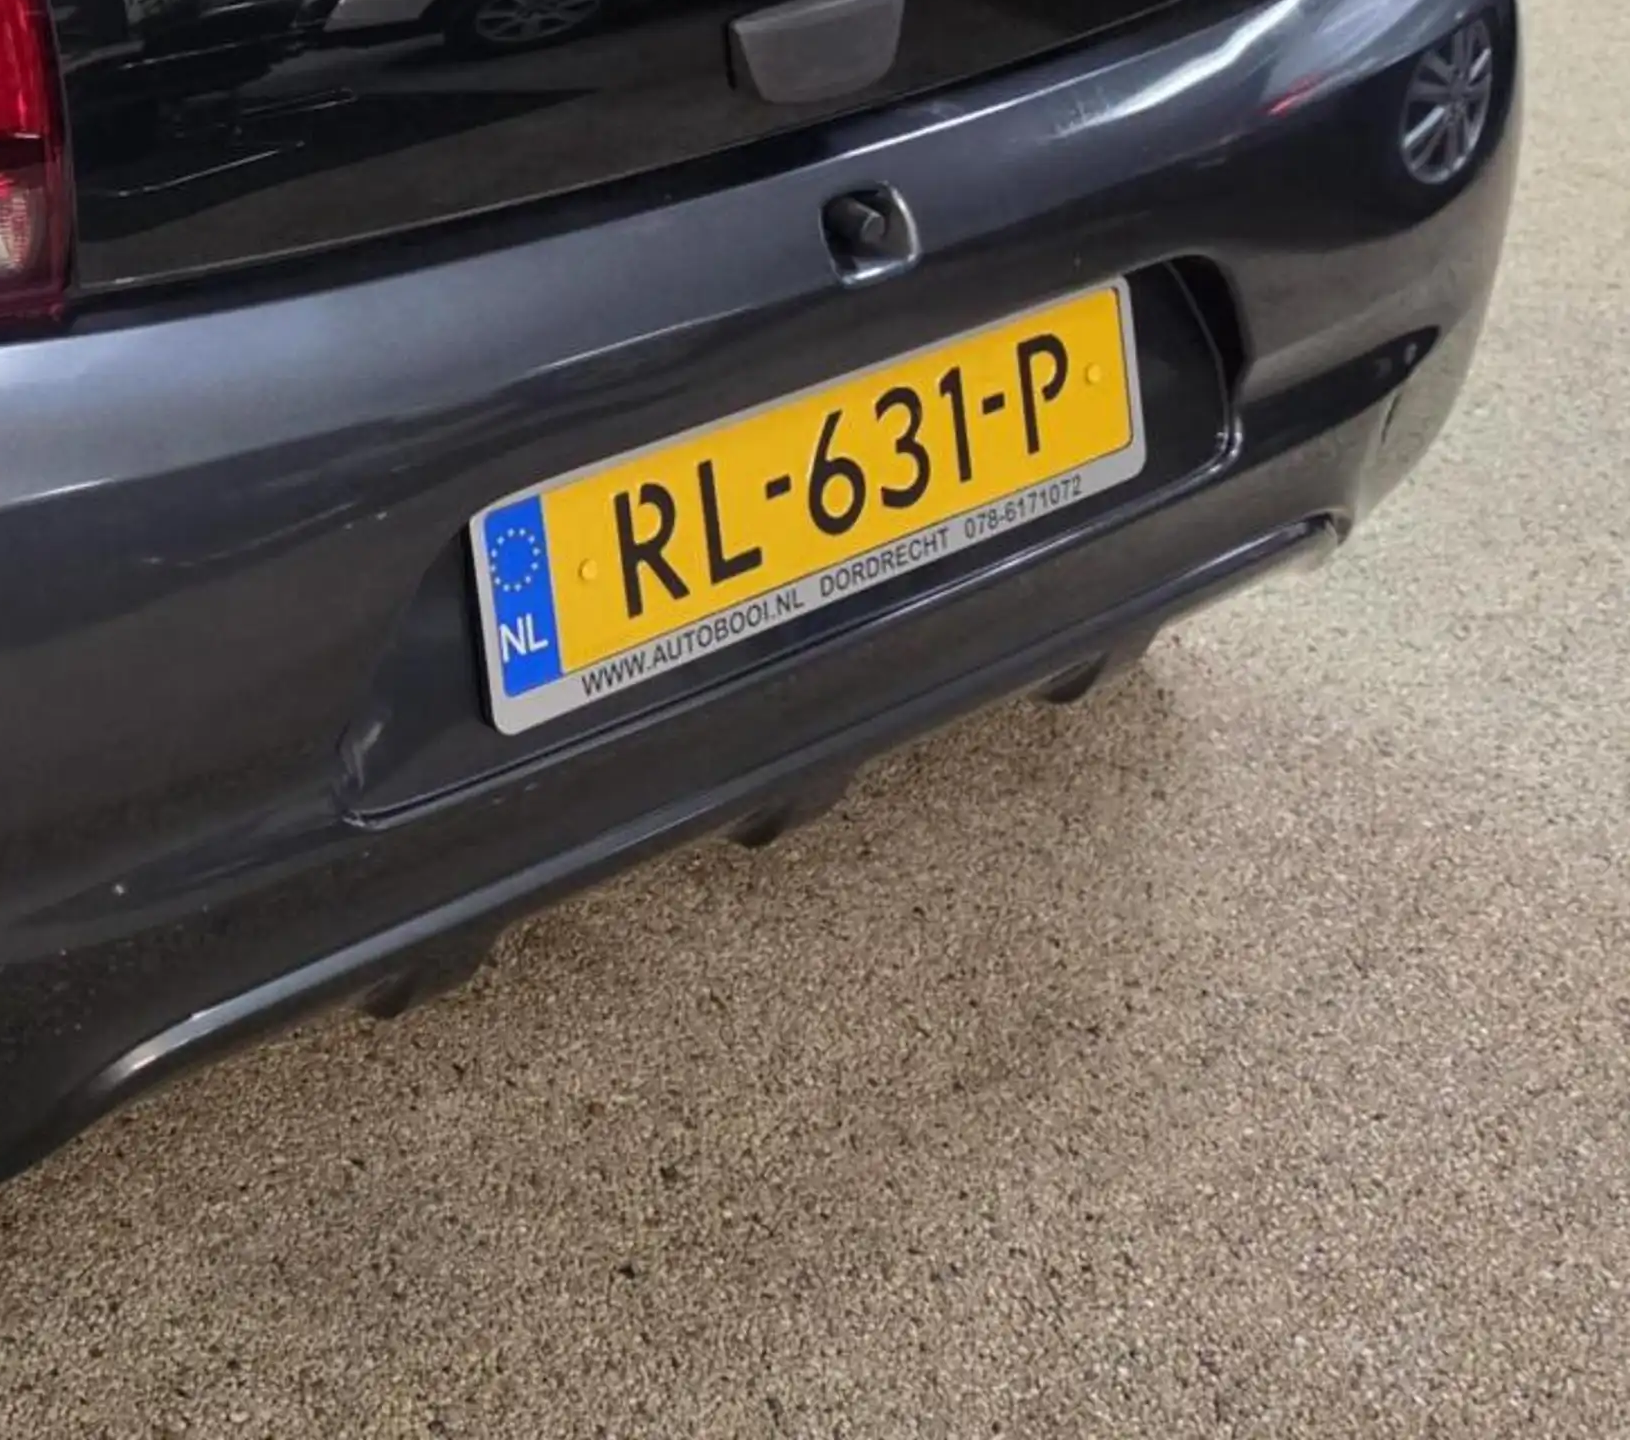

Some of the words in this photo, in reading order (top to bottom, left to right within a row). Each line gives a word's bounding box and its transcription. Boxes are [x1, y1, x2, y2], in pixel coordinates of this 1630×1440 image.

[580, 591, 805, 698] WWW.AUTOBOOI.NL
[819, 526, 950, 599] DORDRECHT
[963, 474, 1083, 541] 078-6171072
[612, 332, 1069, 619] RL-631-P
[499, 612, 549, 662] NL
